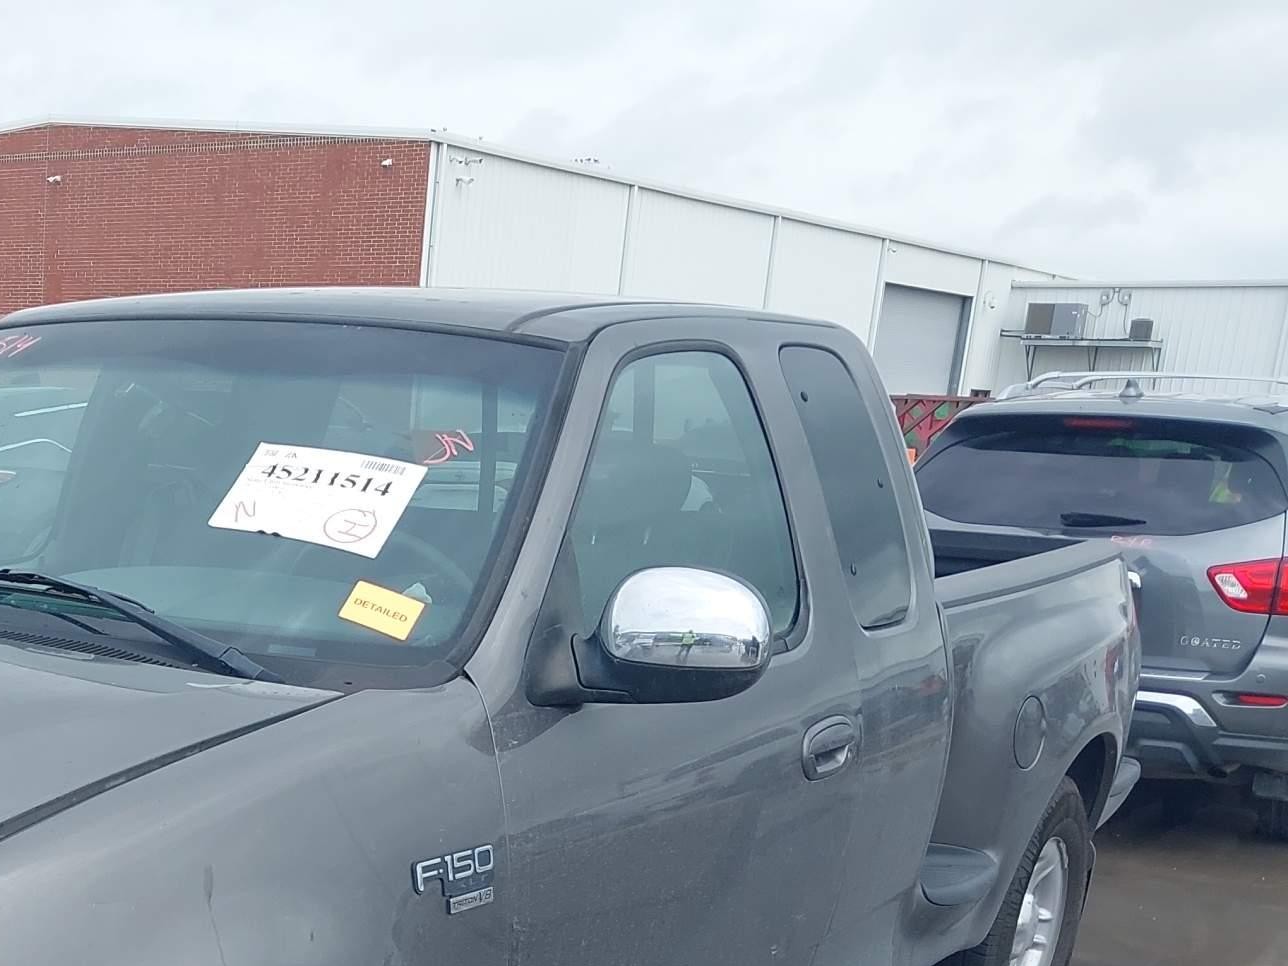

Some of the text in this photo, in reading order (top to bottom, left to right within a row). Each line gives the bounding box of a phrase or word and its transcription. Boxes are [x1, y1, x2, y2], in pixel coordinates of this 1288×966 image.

[260, 463, 393, 496] 45211514
[353, 596, 409, 624] DETAILED
[477, 889, 492, 903] V8
